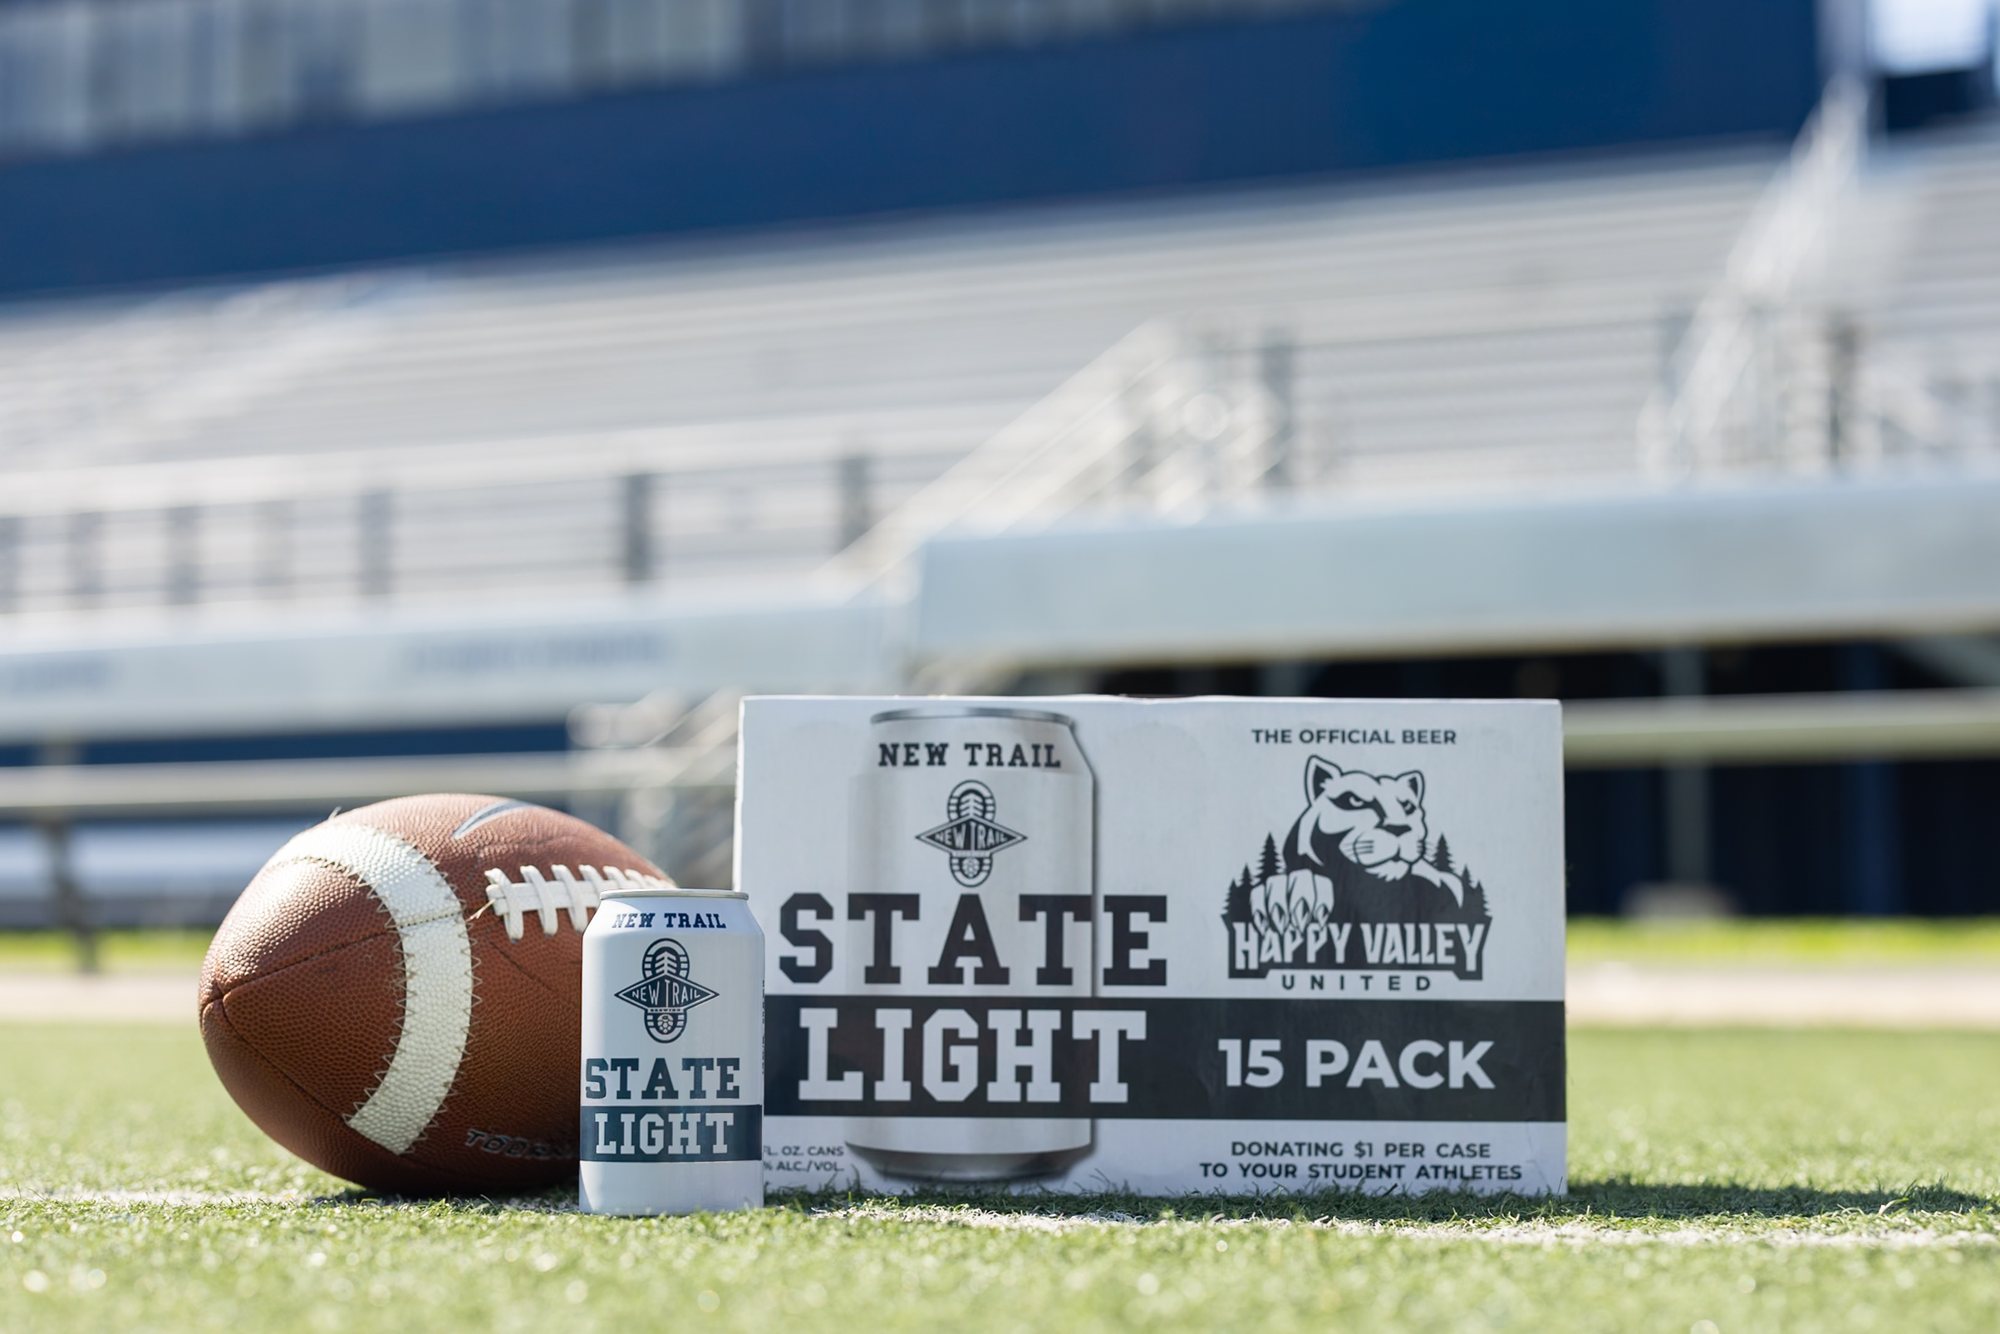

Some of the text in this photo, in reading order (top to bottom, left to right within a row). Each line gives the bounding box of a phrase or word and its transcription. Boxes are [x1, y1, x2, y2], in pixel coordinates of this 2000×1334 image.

[1252, 729, 1457, 744] THE OFFICIAL BEER
[878, 743, 1061, 768] NEW TRAIL
[934, 821, 1009, 851] NEW TRAIL
[612, 913, 727, 929] NEW TRAIL
[779, 893, 1167, 986] STATE
[1232, 922, 1485, 971] HAPPY VALLEY
[632, 979, 700, 1008] NEW TRAIL
[1282, 975, 1431, 990] UNITED
[799, 1008, 1147, 1103] LIGHT
[1218, 1039, 1496, 1089] 15 PACK
[585, 1057, 740, 1100] STATE
[595, 1112, 734, 1155] LIGHT
[807, 1145, 845, 1157] CANS
[1231, 1141, 1492, 1159] DONATING $1 PER CASE
[1200, 1163, 1523, 1181] TO YOUR STUDENT ATHLETES
